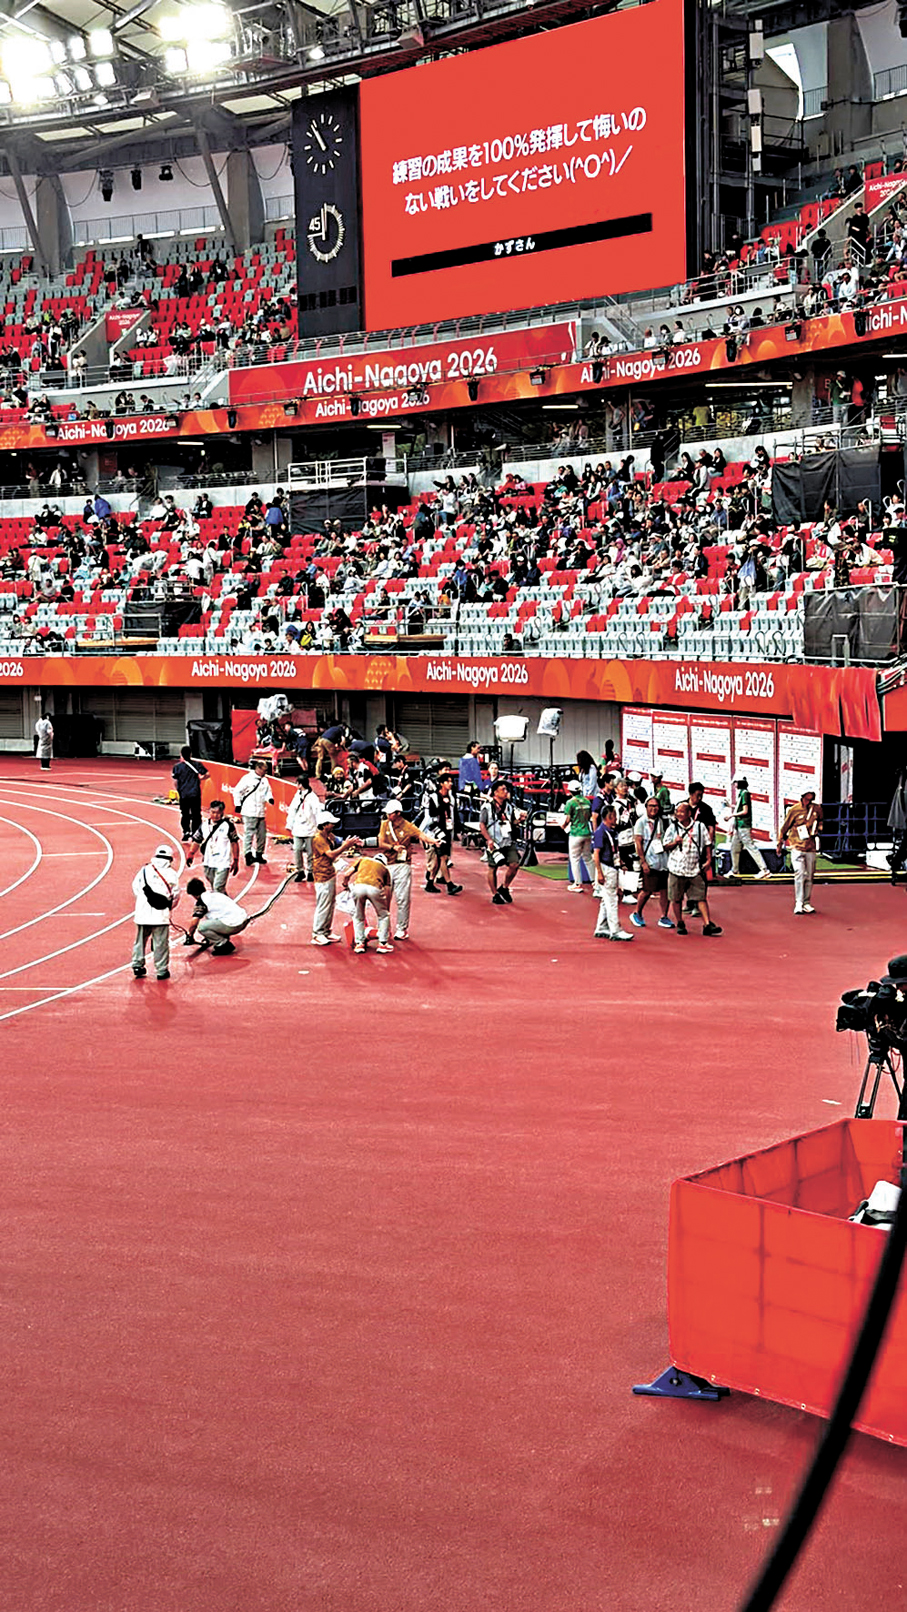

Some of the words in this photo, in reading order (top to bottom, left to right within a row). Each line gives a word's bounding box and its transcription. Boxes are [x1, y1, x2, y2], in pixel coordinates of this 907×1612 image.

[392, 107, 647, 185] 練習の成果を100%発揮して悔いの
[309, 217, 321, 231] 45
[494, 237, 536, 256] かずさん
[865, 305, 907, 332] ichi-N
[303, 359, 442, 395] Aichi-Nagoya
[447, 347, 498, 378] 2026
[580, 359, 666, 384] Aii-Nagoya
[668, 347, 701, 370] 2026
[315, 397, 398, 418] Aichi-agoya
[191, 659, 268, 682] Aichi-Nagoya
[270, 660, 297, 678] 2026
[426, 660, 498, 688] Aichi-Nagoya
[500, 663, 528, 684] 2026
[675, 666, 743, 703] Aichi-Nagoya
[745, 671, 775, 698] 2026
